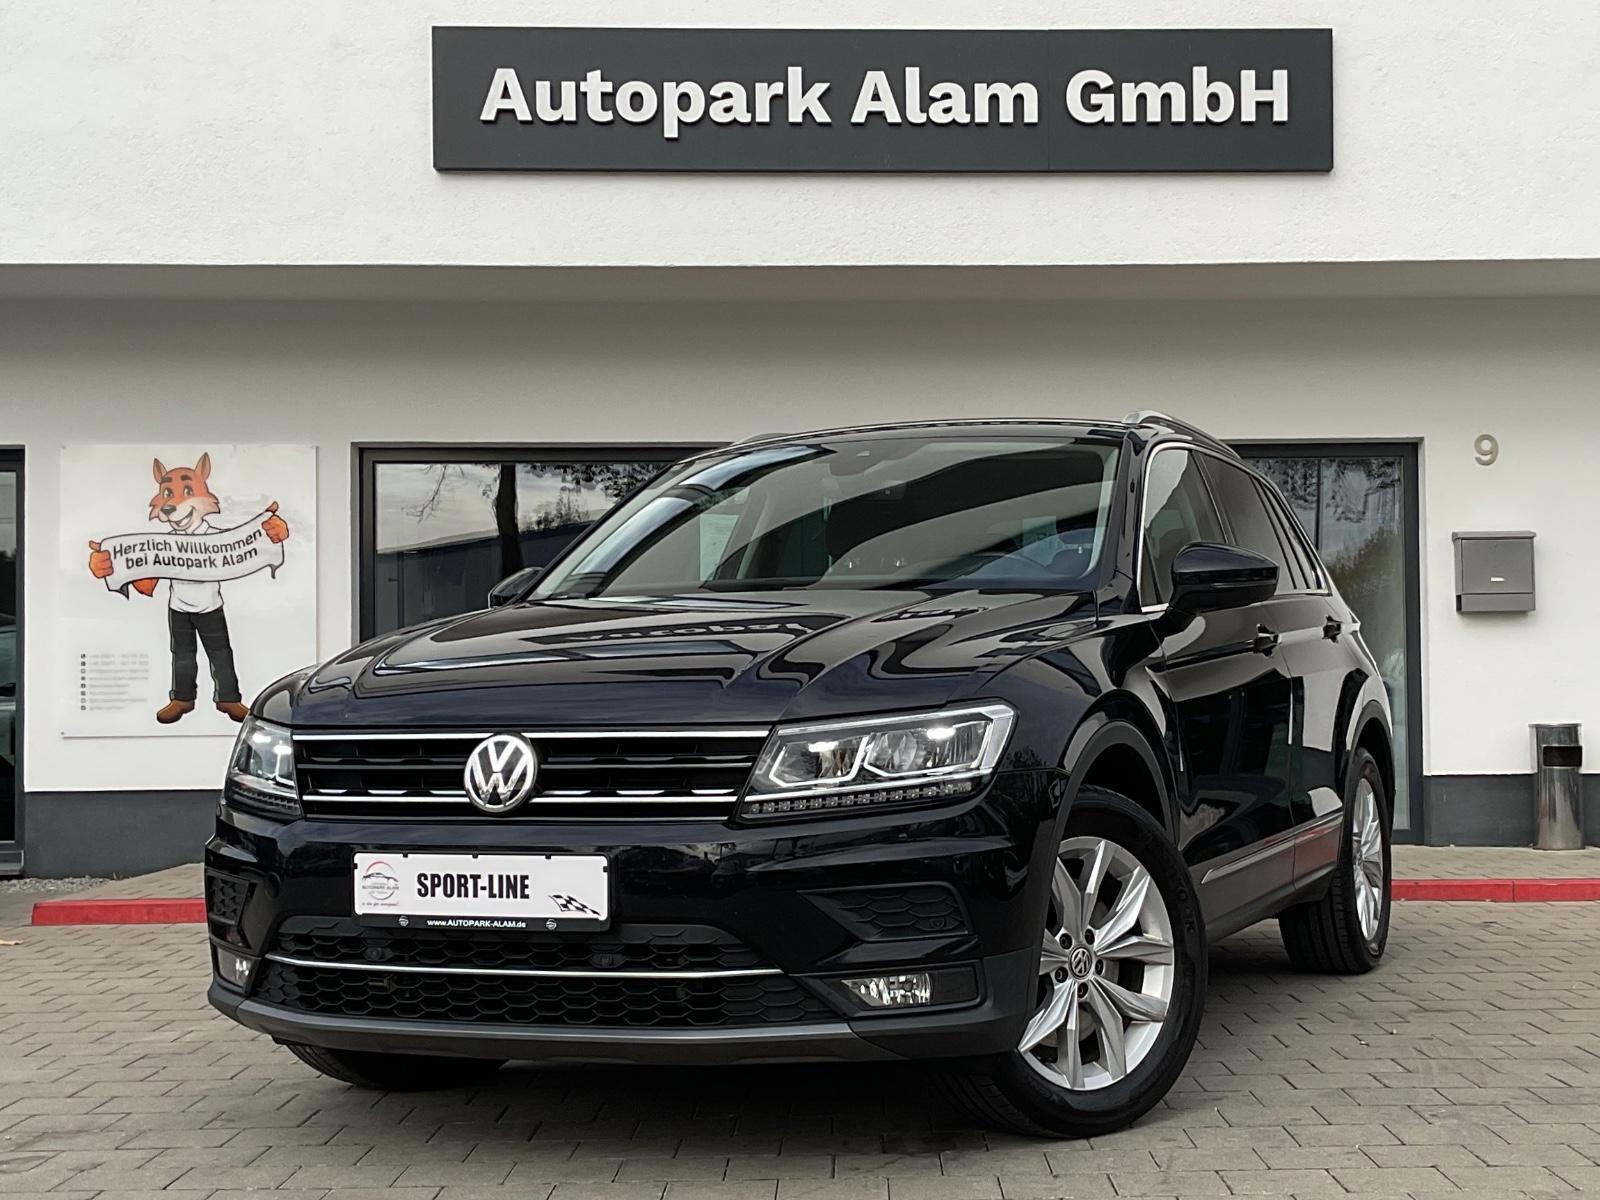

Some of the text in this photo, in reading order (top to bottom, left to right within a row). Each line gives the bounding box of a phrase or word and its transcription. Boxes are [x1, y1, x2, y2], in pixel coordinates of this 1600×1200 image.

[480, 66, 1289, 140] Autopark Alam GmbH
[1474, 434, 1499, 466] 9
[113, 528, 263, 559] Herzlich Willkommen
[126, 547, 258, 569] bei Autopark Alam
[465, 736, 535, 810] VW
[417, 872, 530, 899] SPORT-LINE
[427, 919, 526, 928] www.AUTOPARK-ALAM.de
